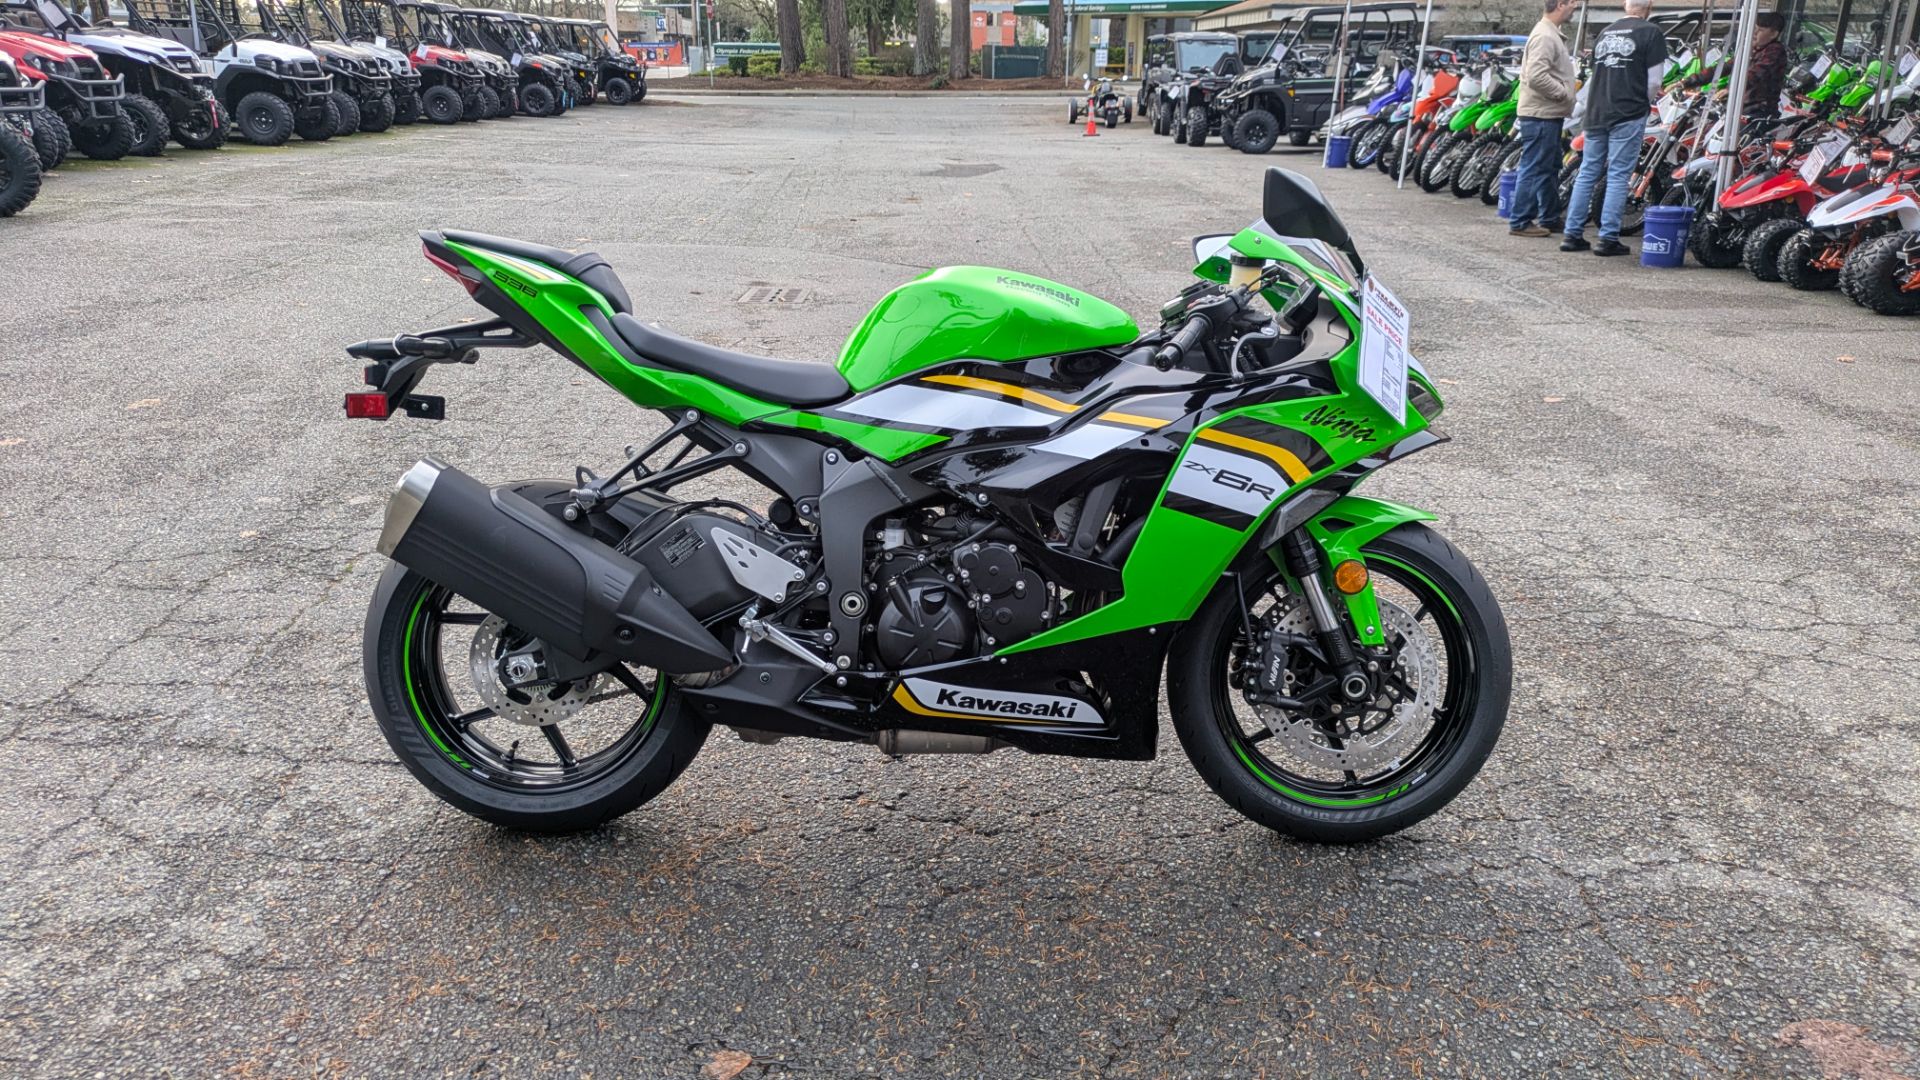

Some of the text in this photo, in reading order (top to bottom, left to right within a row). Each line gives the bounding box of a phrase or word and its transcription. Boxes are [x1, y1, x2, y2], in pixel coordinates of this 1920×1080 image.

[996, 276, 1080, 307] Kawasaki
[1366, 305, 1383, 328] SALE
[1384, 322, 1403, 348] PRICE
[1303, 404, 1376, 442] Ninja
[936, 688, 1077, 719] Kawasaki
